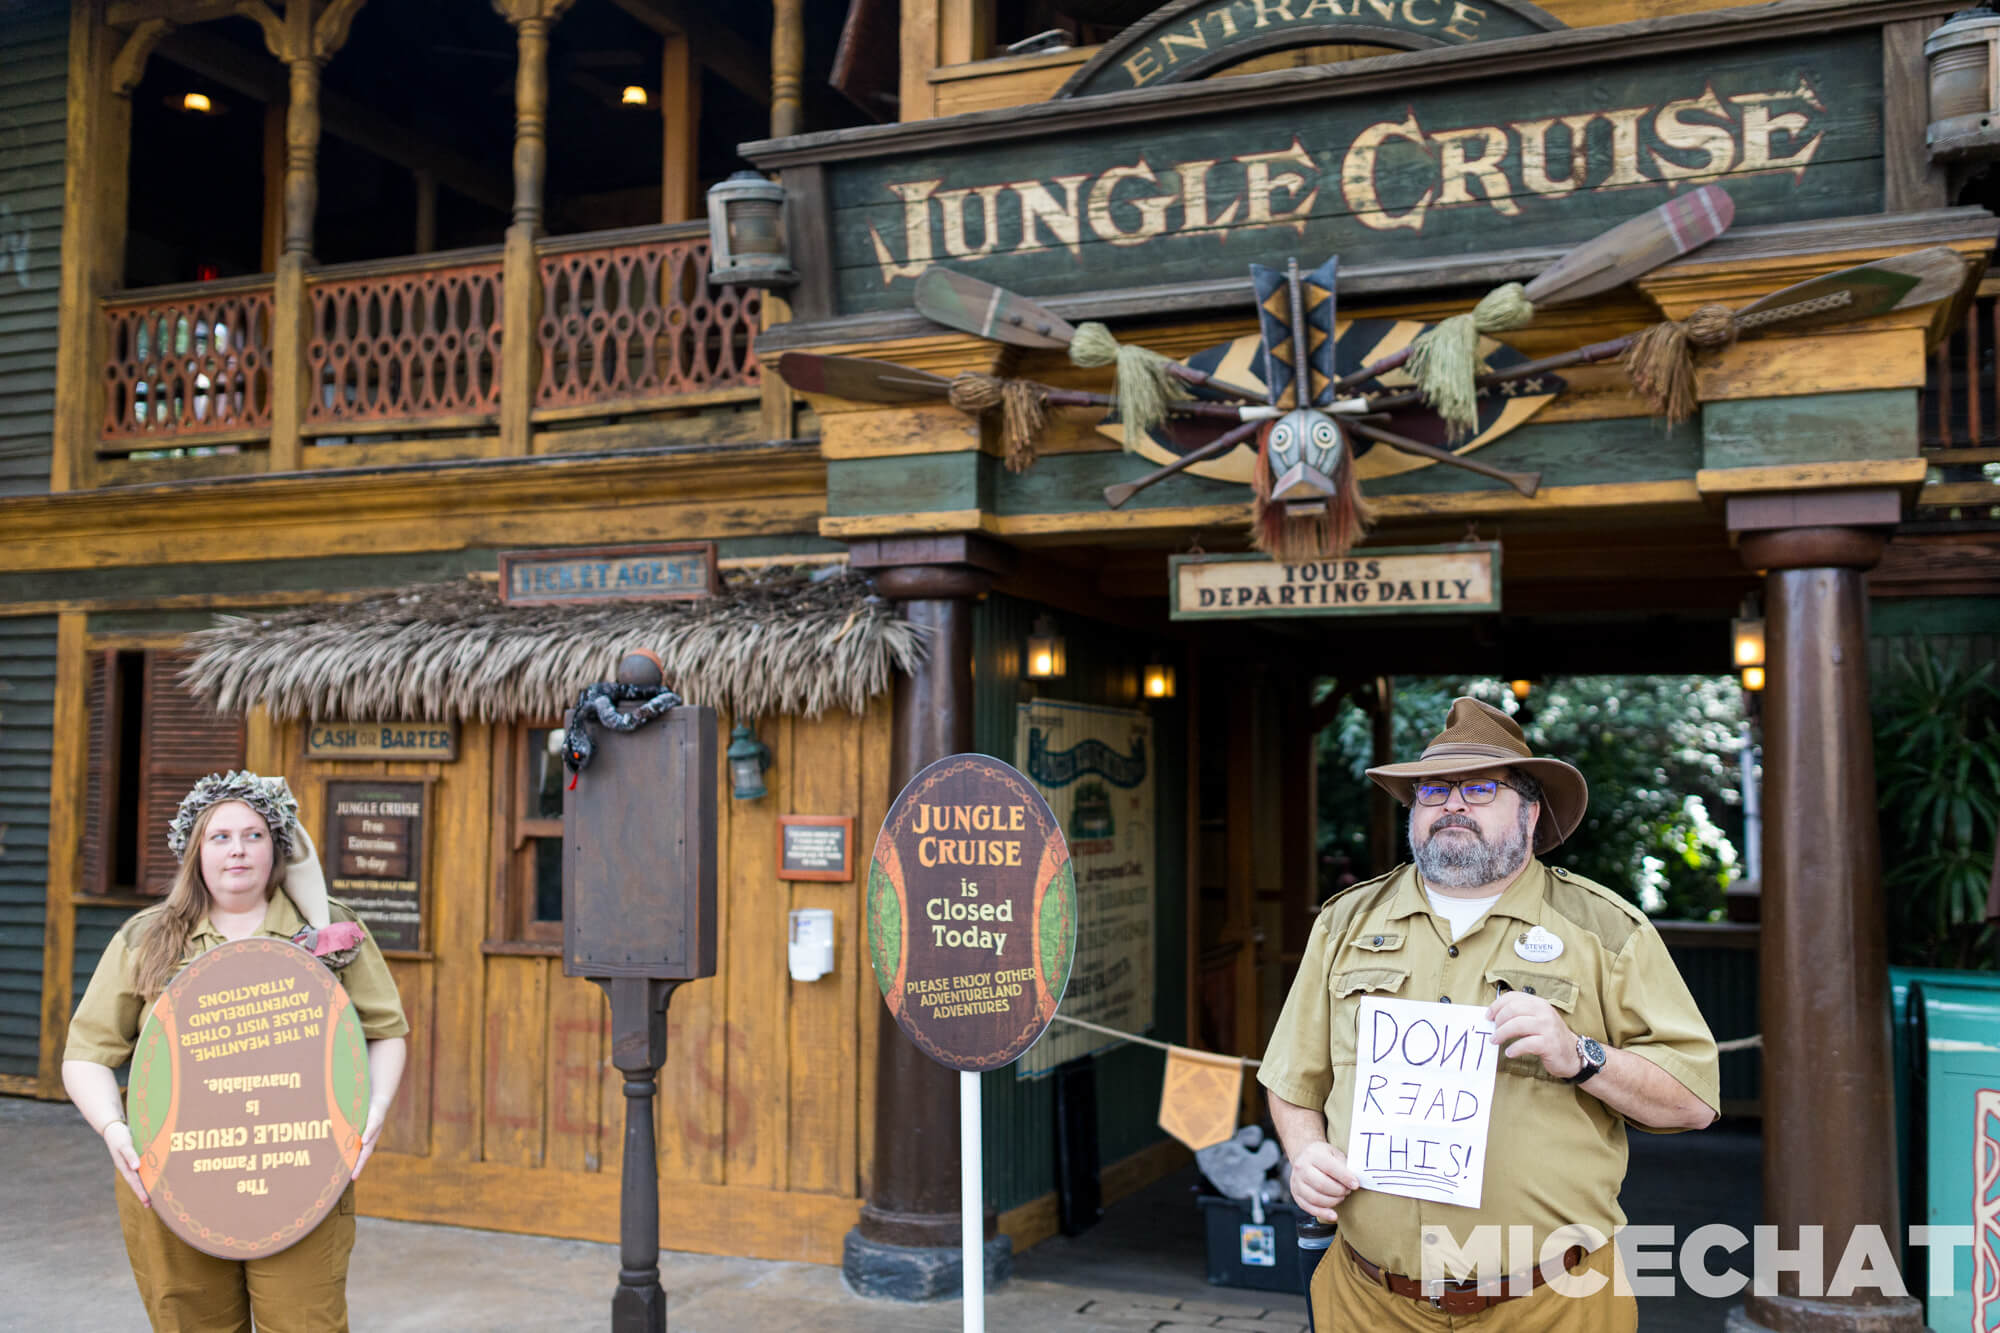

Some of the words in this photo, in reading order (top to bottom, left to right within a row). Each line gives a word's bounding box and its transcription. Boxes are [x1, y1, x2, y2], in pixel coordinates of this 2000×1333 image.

[1121, 0, 1488, 88] ENTRANCE
[869, 137, 1320, 286] JUNGLE
[1341, 75, 1828, 239] CRUISE
[517, 562, 611, 593] TICKET
[615, 558, 701, 588] AGENT
[1281, 560, 1382, 583] TOURS
[1199, 581, 1371, 608] DEPARTING
[1378, 578, 1473, 602] DAILY
[309, 727, 357, 749] CASH
[380, 727, 450, 749] BARTER
[336, 801, 378, 817] JUNGLE
[379, 801, 420, 817] CRUISE
[912, 803, 1026, 834] JUNGLE
[918, 836, 1022, 868] CRUISE
[961, 878, 979, 898] is
[926, 898, 1014, 922] Closed
[932, 925, 1007, 956] Today
[197, 976, 296, 1009] ATTRACTIONS
[906, 976, 950, 995] PLEASE
[953, 972, 991, 991] ENJOY
[994, 967, 1037, 985] OTHER
[920, 983, 1022, 1008] ADVENTURELAND
[188, 991, 311, 1029] ADVENTURELAND
[272, 1005, 324, 1029] PLEASE
[932, 999, 1010, 1020] ADVENTURES
[180, 1025, 232, 1048] OTHER
[235, 1018, 270, 1037] VISIT
[273, 1027, 302, 1045] THE
[303, 1023, 321, 1039] IN
[188, 1038, 271, 1063] MEANTIME,
[203, 1072, 302, 1095] Unavailable.
[170, 1126, 248, 1153] CRUISE
[253, 1119, 333, 1146] JUNGLE
[192, 1154, 258, 1173] Famous
[262, 1151, 311, 1169] World
[1359, 1132, 1473, 1180] THIS!
[236, 1178, 269, 1196] The
